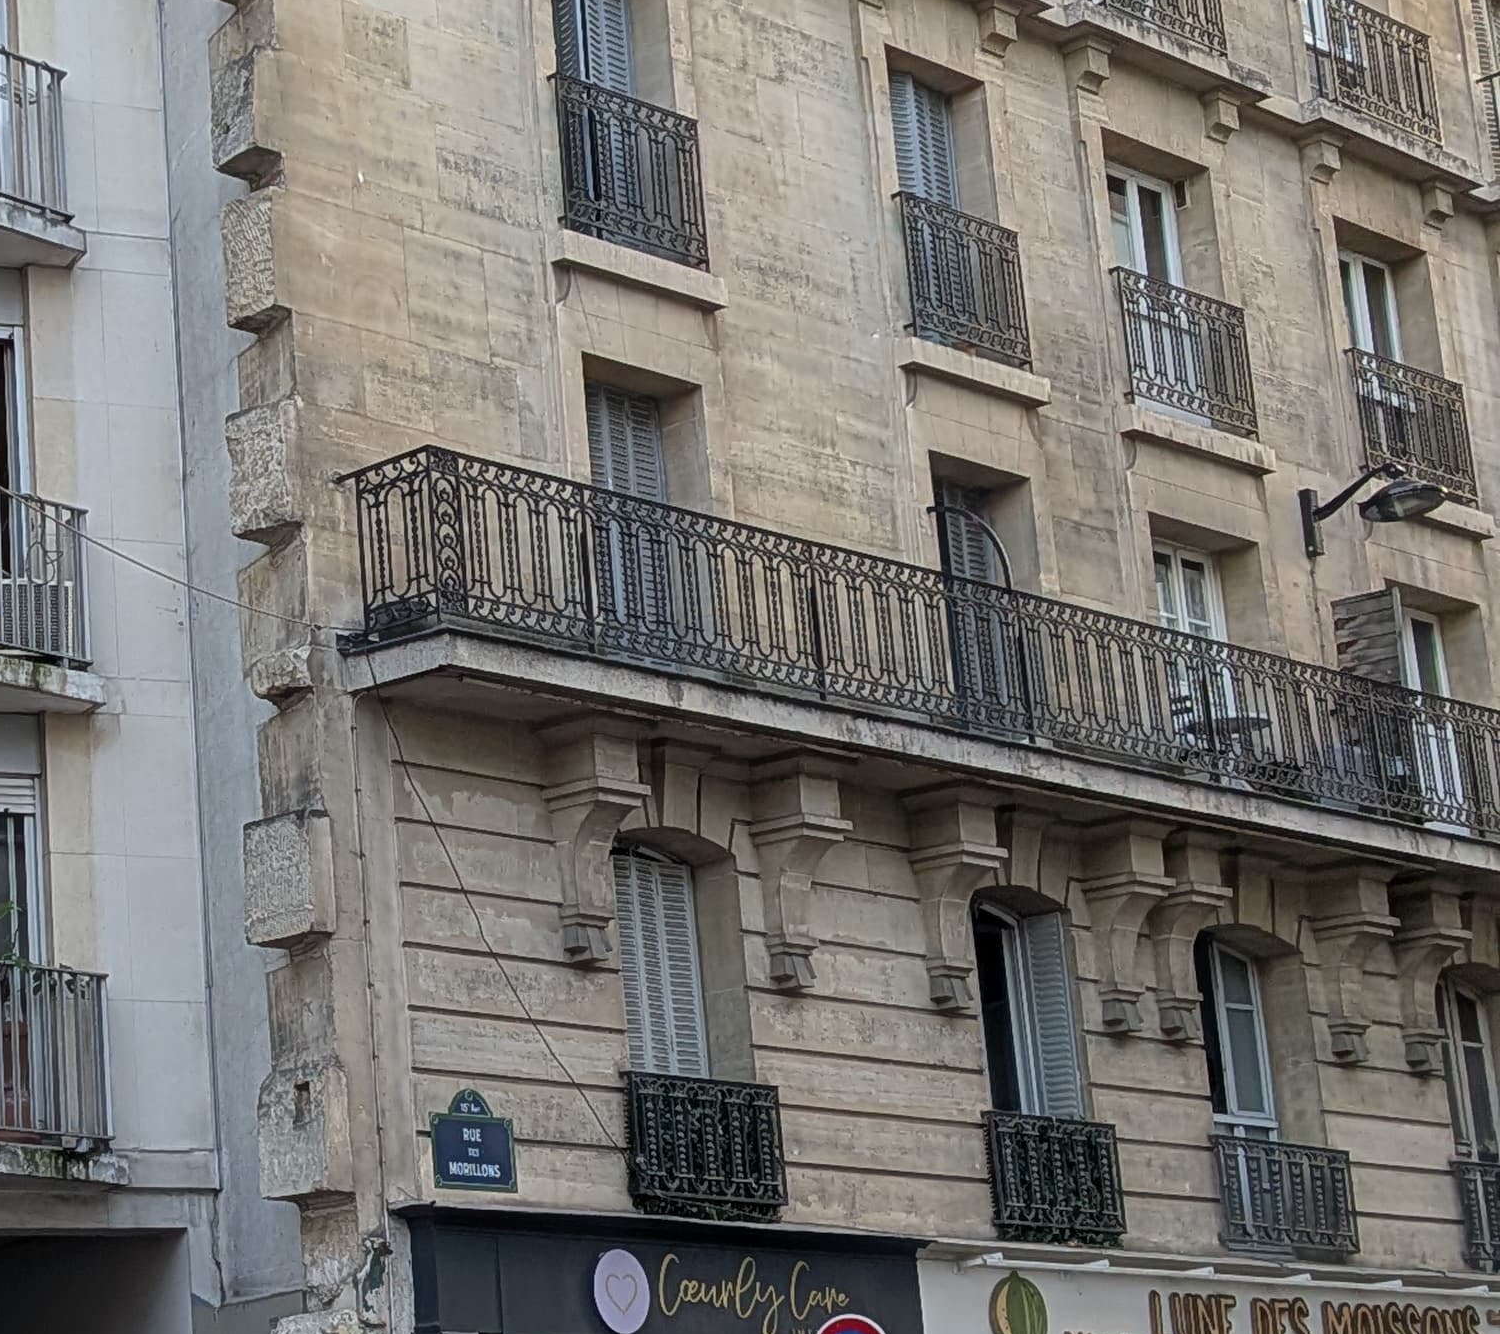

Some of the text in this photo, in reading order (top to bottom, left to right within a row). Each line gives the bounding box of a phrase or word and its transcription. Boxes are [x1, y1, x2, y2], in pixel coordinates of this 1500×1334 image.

[462, 1128, 482, 1142] RUE
[448, 1161, 501, 1178] MORILLONS
[790, 1260, 850, 1321] Care
